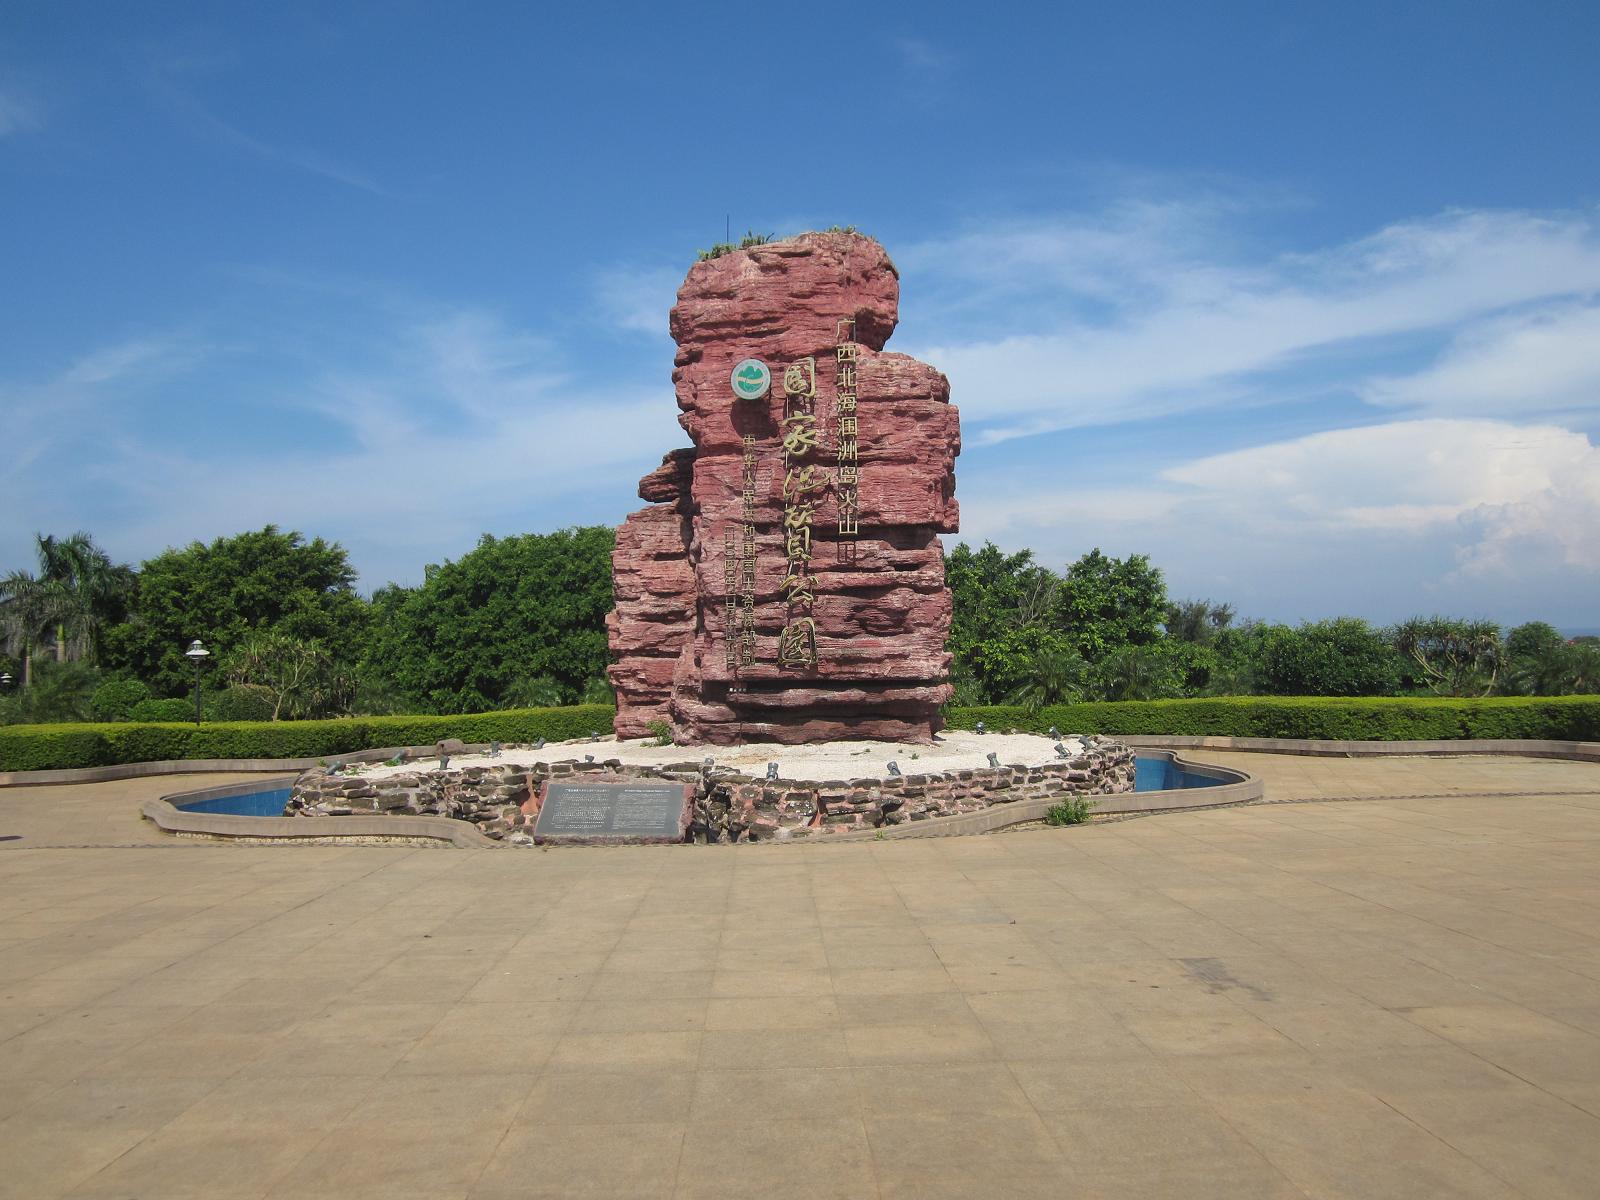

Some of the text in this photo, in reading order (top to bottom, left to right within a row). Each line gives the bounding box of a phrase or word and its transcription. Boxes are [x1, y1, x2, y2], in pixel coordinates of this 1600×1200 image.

[836, 318, 858, 535] 广西北海涠洲岛火山
